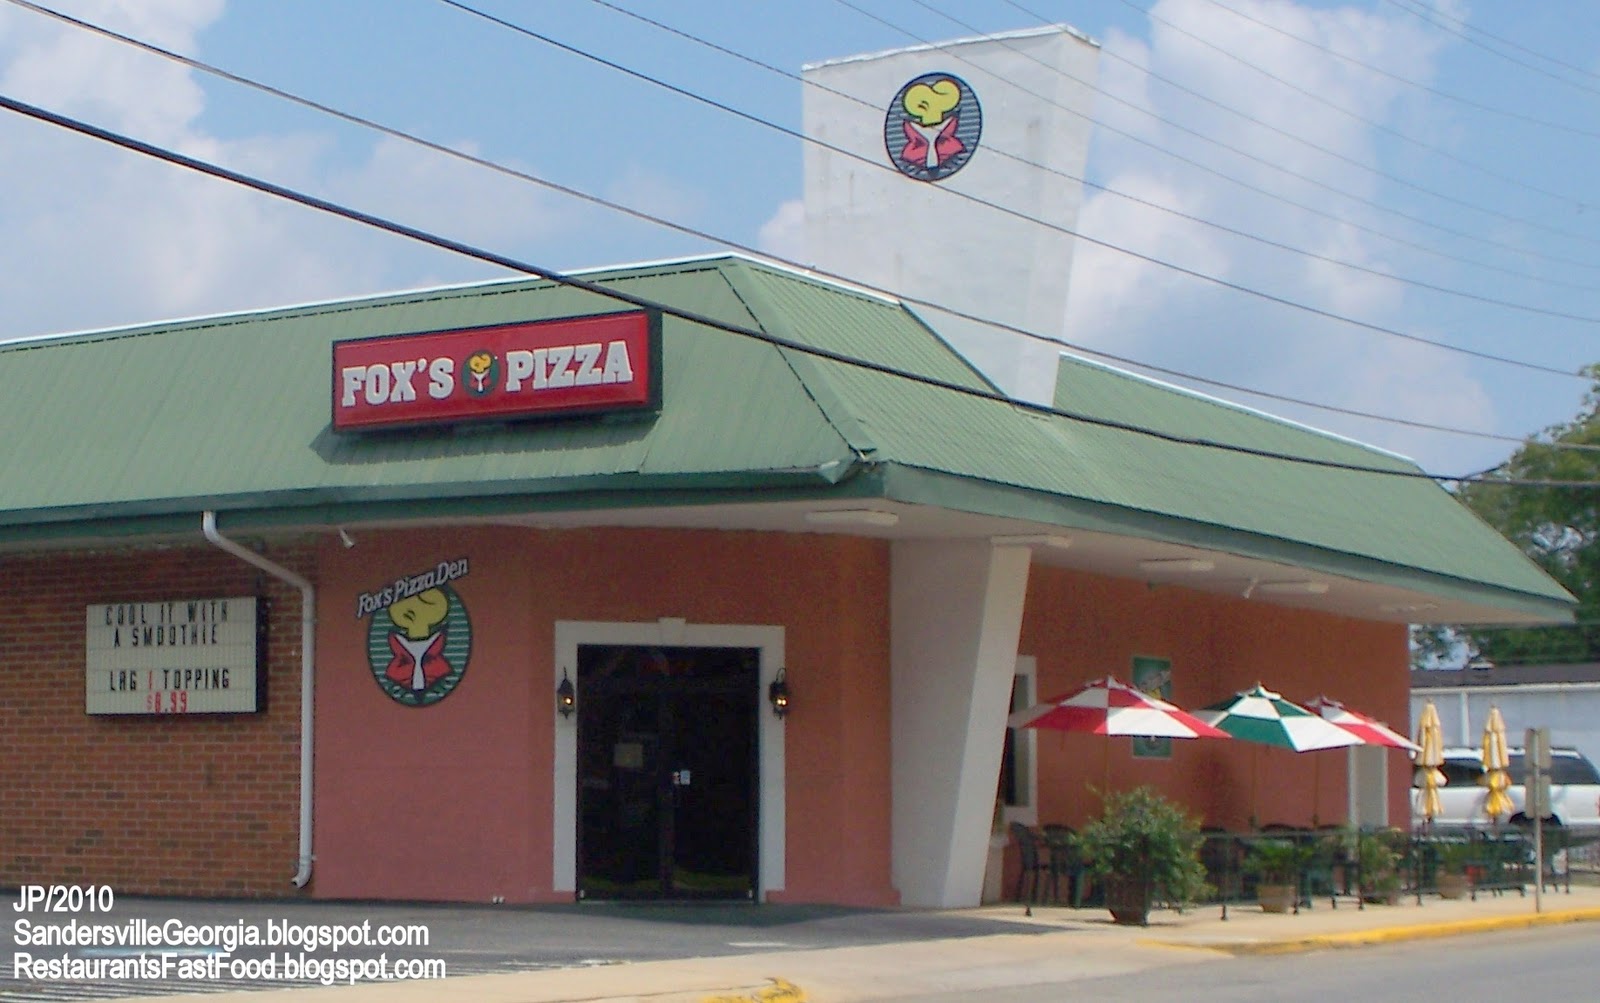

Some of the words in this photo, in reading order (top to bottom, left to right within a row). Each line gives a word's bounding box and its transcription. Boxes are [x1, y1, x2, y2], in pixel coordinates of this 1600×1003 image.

[342, 357, 454, 407] FOX'S
[505, 340, 633, 392] PIZZA
[393, 571, 435, 602] Pizza
[435, 558, 468, 585] Den
[105, 604, 147, 625] COOL
[160, 603, 174, 623] IT
[187, 601, 228, 622] WITH
[113, 627, 121, 647] A
[132, 624, 218, 646] SMOOTHIE
[163, 668, 230, 690] TOPPING
